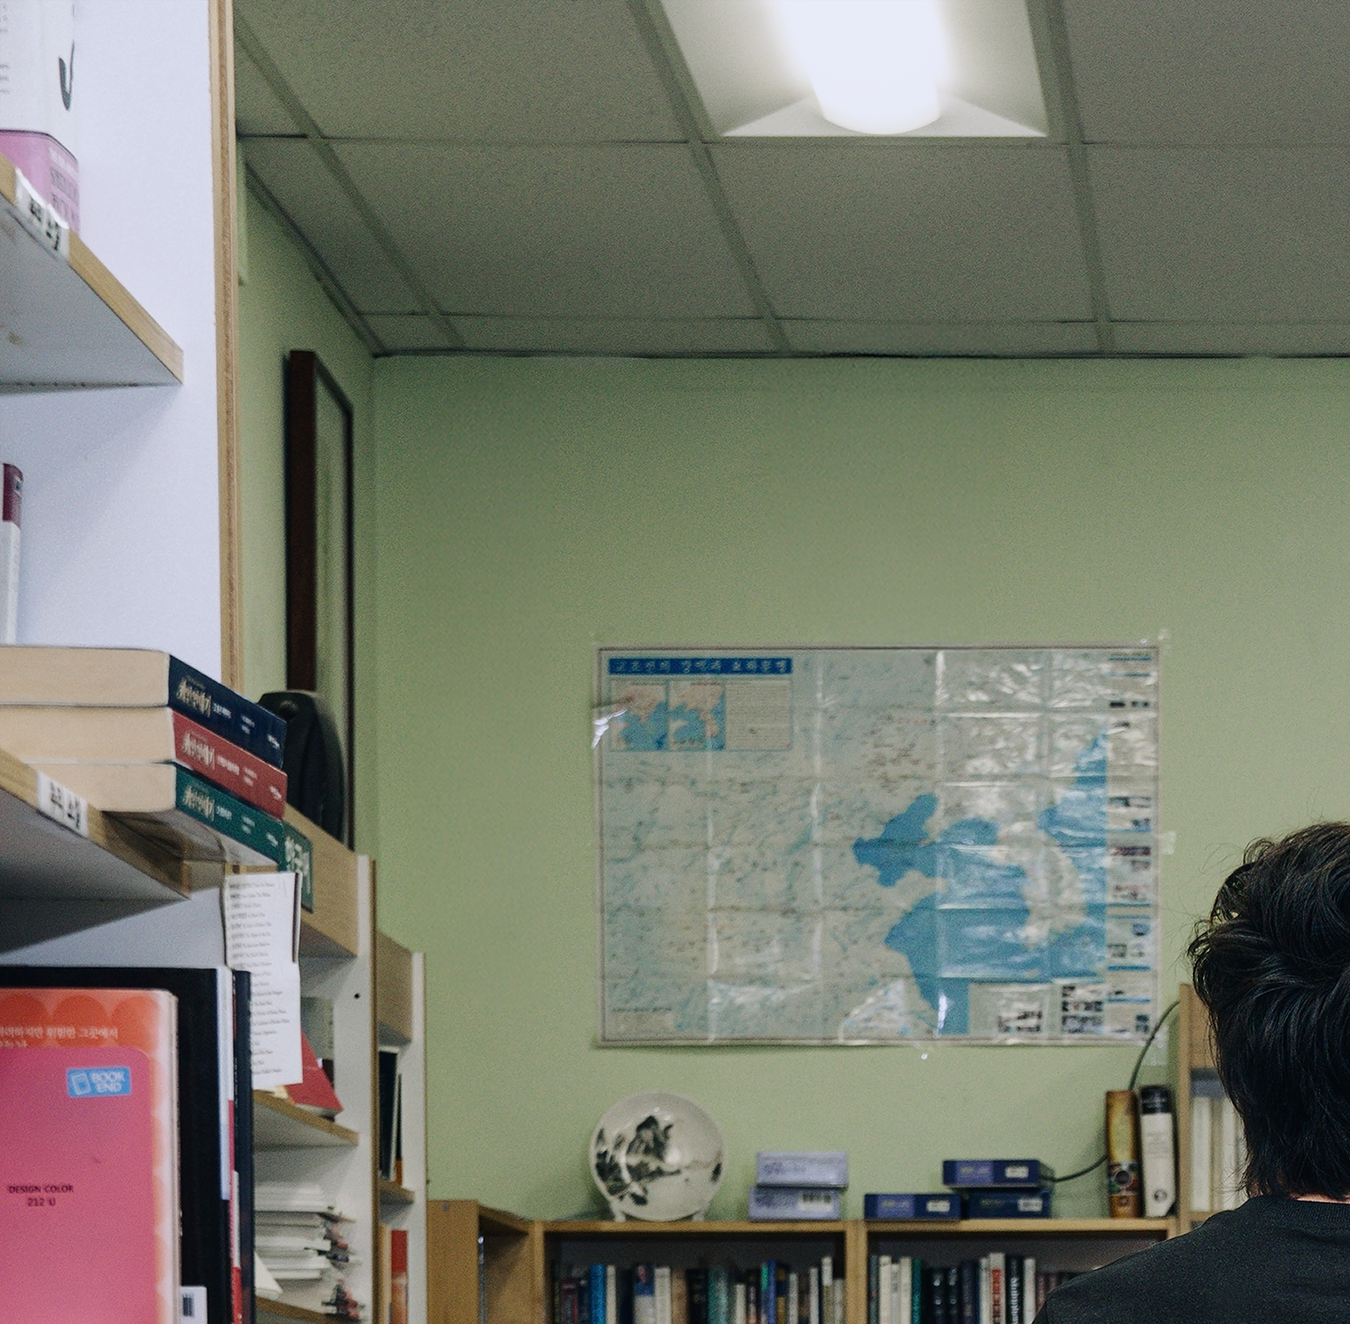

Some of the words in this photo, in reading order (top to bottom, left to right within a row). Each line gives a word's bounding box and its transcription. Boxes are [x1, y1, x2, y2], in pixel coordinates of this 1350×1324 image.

[90, 1071, 125, 1083] BOOK
[97, 1082, 122, 1093] END
[9, 1185, 41, 1194] DESIGN
[44, 1185, 75, 1194] COLOR
[28, 1198, 44, 1206] 212
